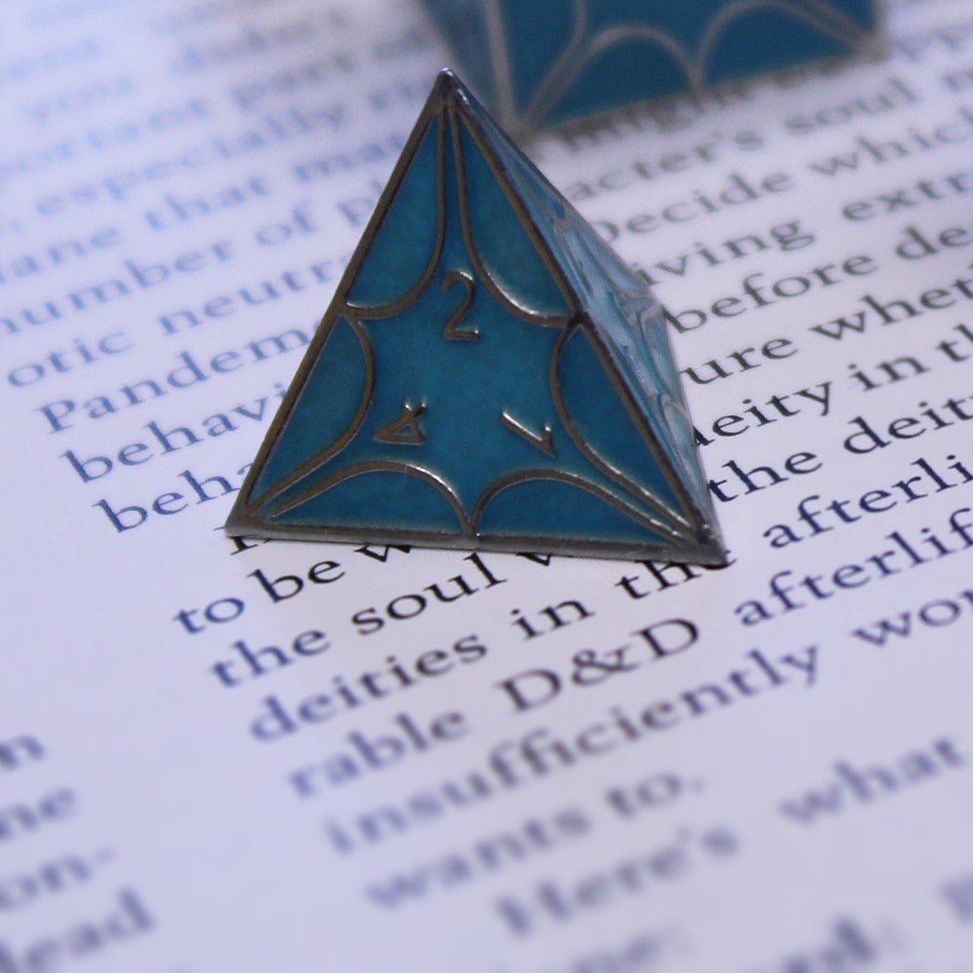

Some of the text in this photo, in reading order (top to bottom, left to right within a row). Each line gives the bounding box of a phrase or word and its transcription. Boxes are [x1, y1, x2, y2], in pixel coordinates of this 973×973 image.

[6, 328, 135, 390] otic
[785, 76, 922, 134] soul
[144, 176, 270, 231] that
[254, 199, 321, 247] of
[443, 271, 480, 342] 2
[661, 252, 881, 335] before
[373, 399, 428, 445] 4
[172, 595, 246, 636] to
[246, 558, 347, 604] be
[847, 354, 932, 392] in
[207, 627, 333, 690] the
[350, 551, 507, 636] soul
[706, 449, 824, 503] the
[248, 634, 489, 743] deities
[507, 597, 597, 641] in
[287, 709, 471, 801] rable
[494, 617, 700, 715] D&D
[322, 643, 821, 856] insufficiently
[777, 736, 967, 825] what
[365, 806, 593, 911] wants
